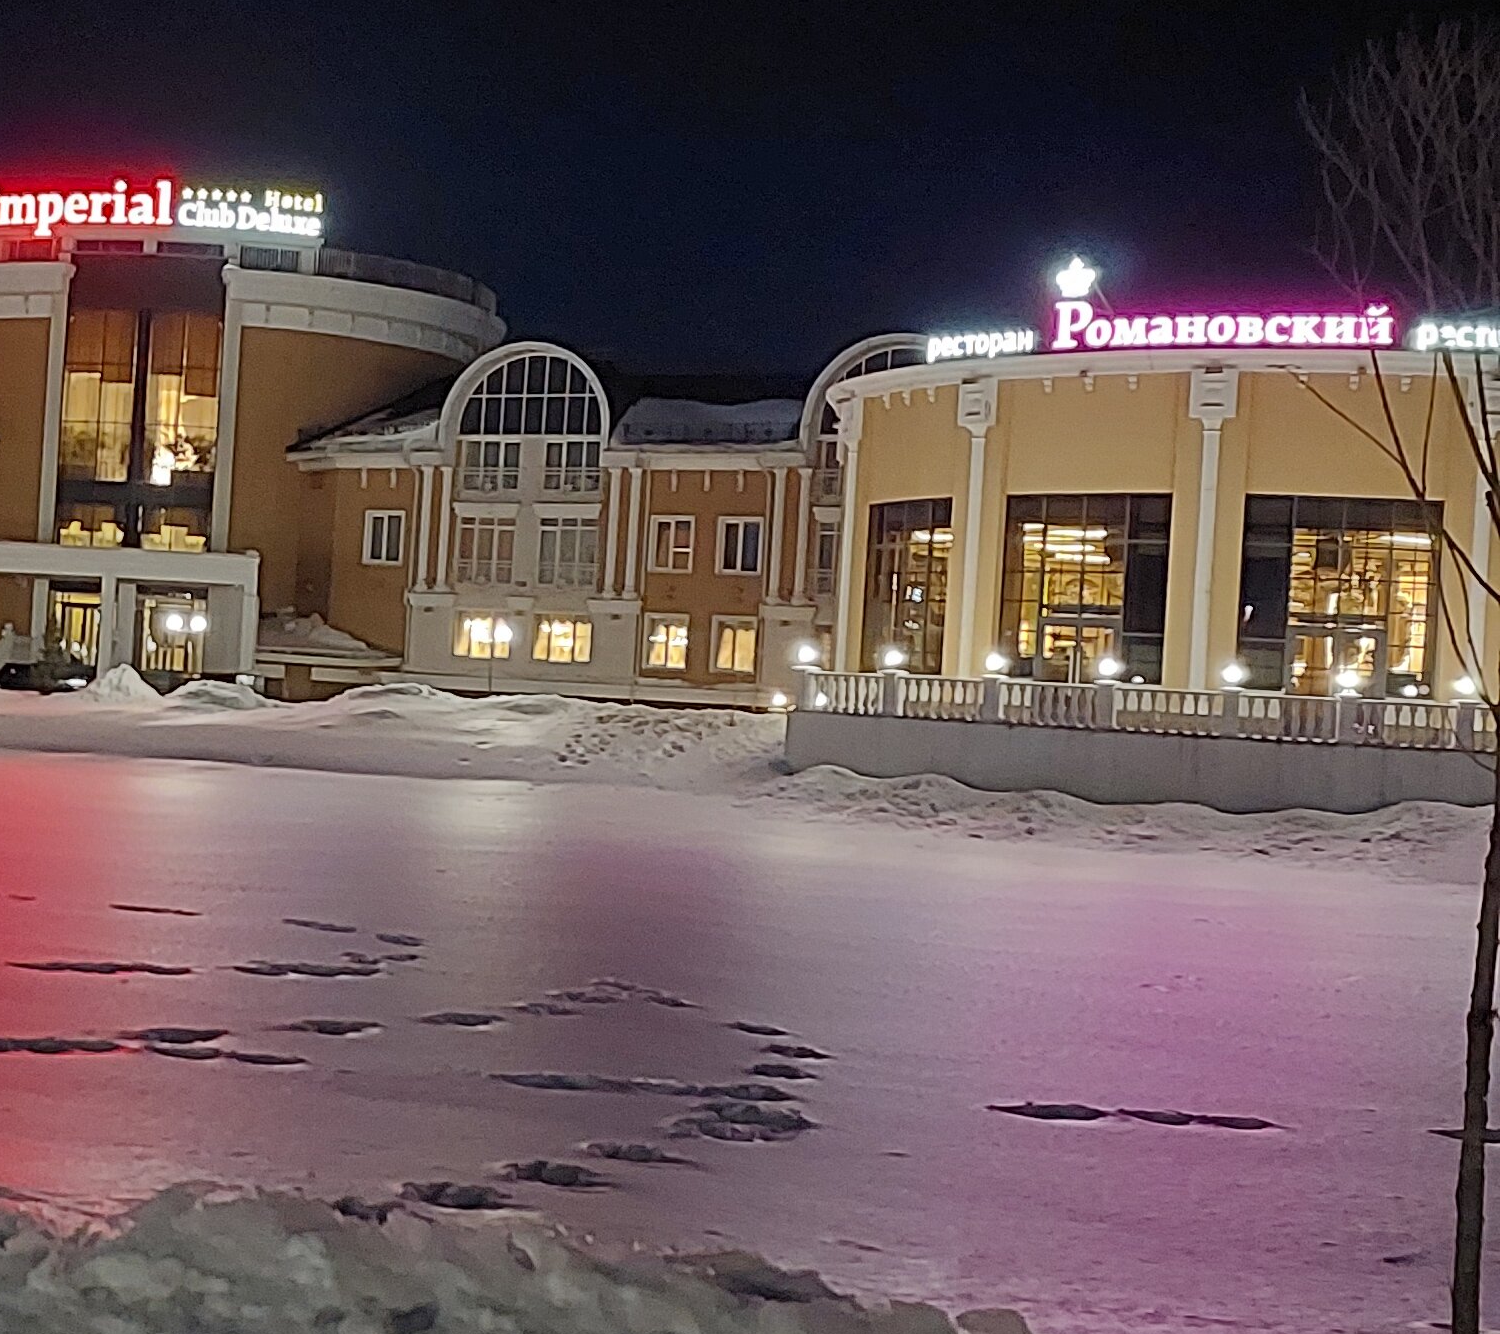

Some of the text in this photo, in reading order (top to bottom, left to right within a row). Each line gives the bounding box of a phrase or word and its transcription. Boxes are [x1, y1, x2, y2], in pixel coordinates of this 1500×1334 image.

[178, 201, 322, 236] Club Deluxe
[264, 189, 323, 213] Hotel
[926, 329, 1034, 364] ресторан
[1051, 300, 1394, 350] Романовский
